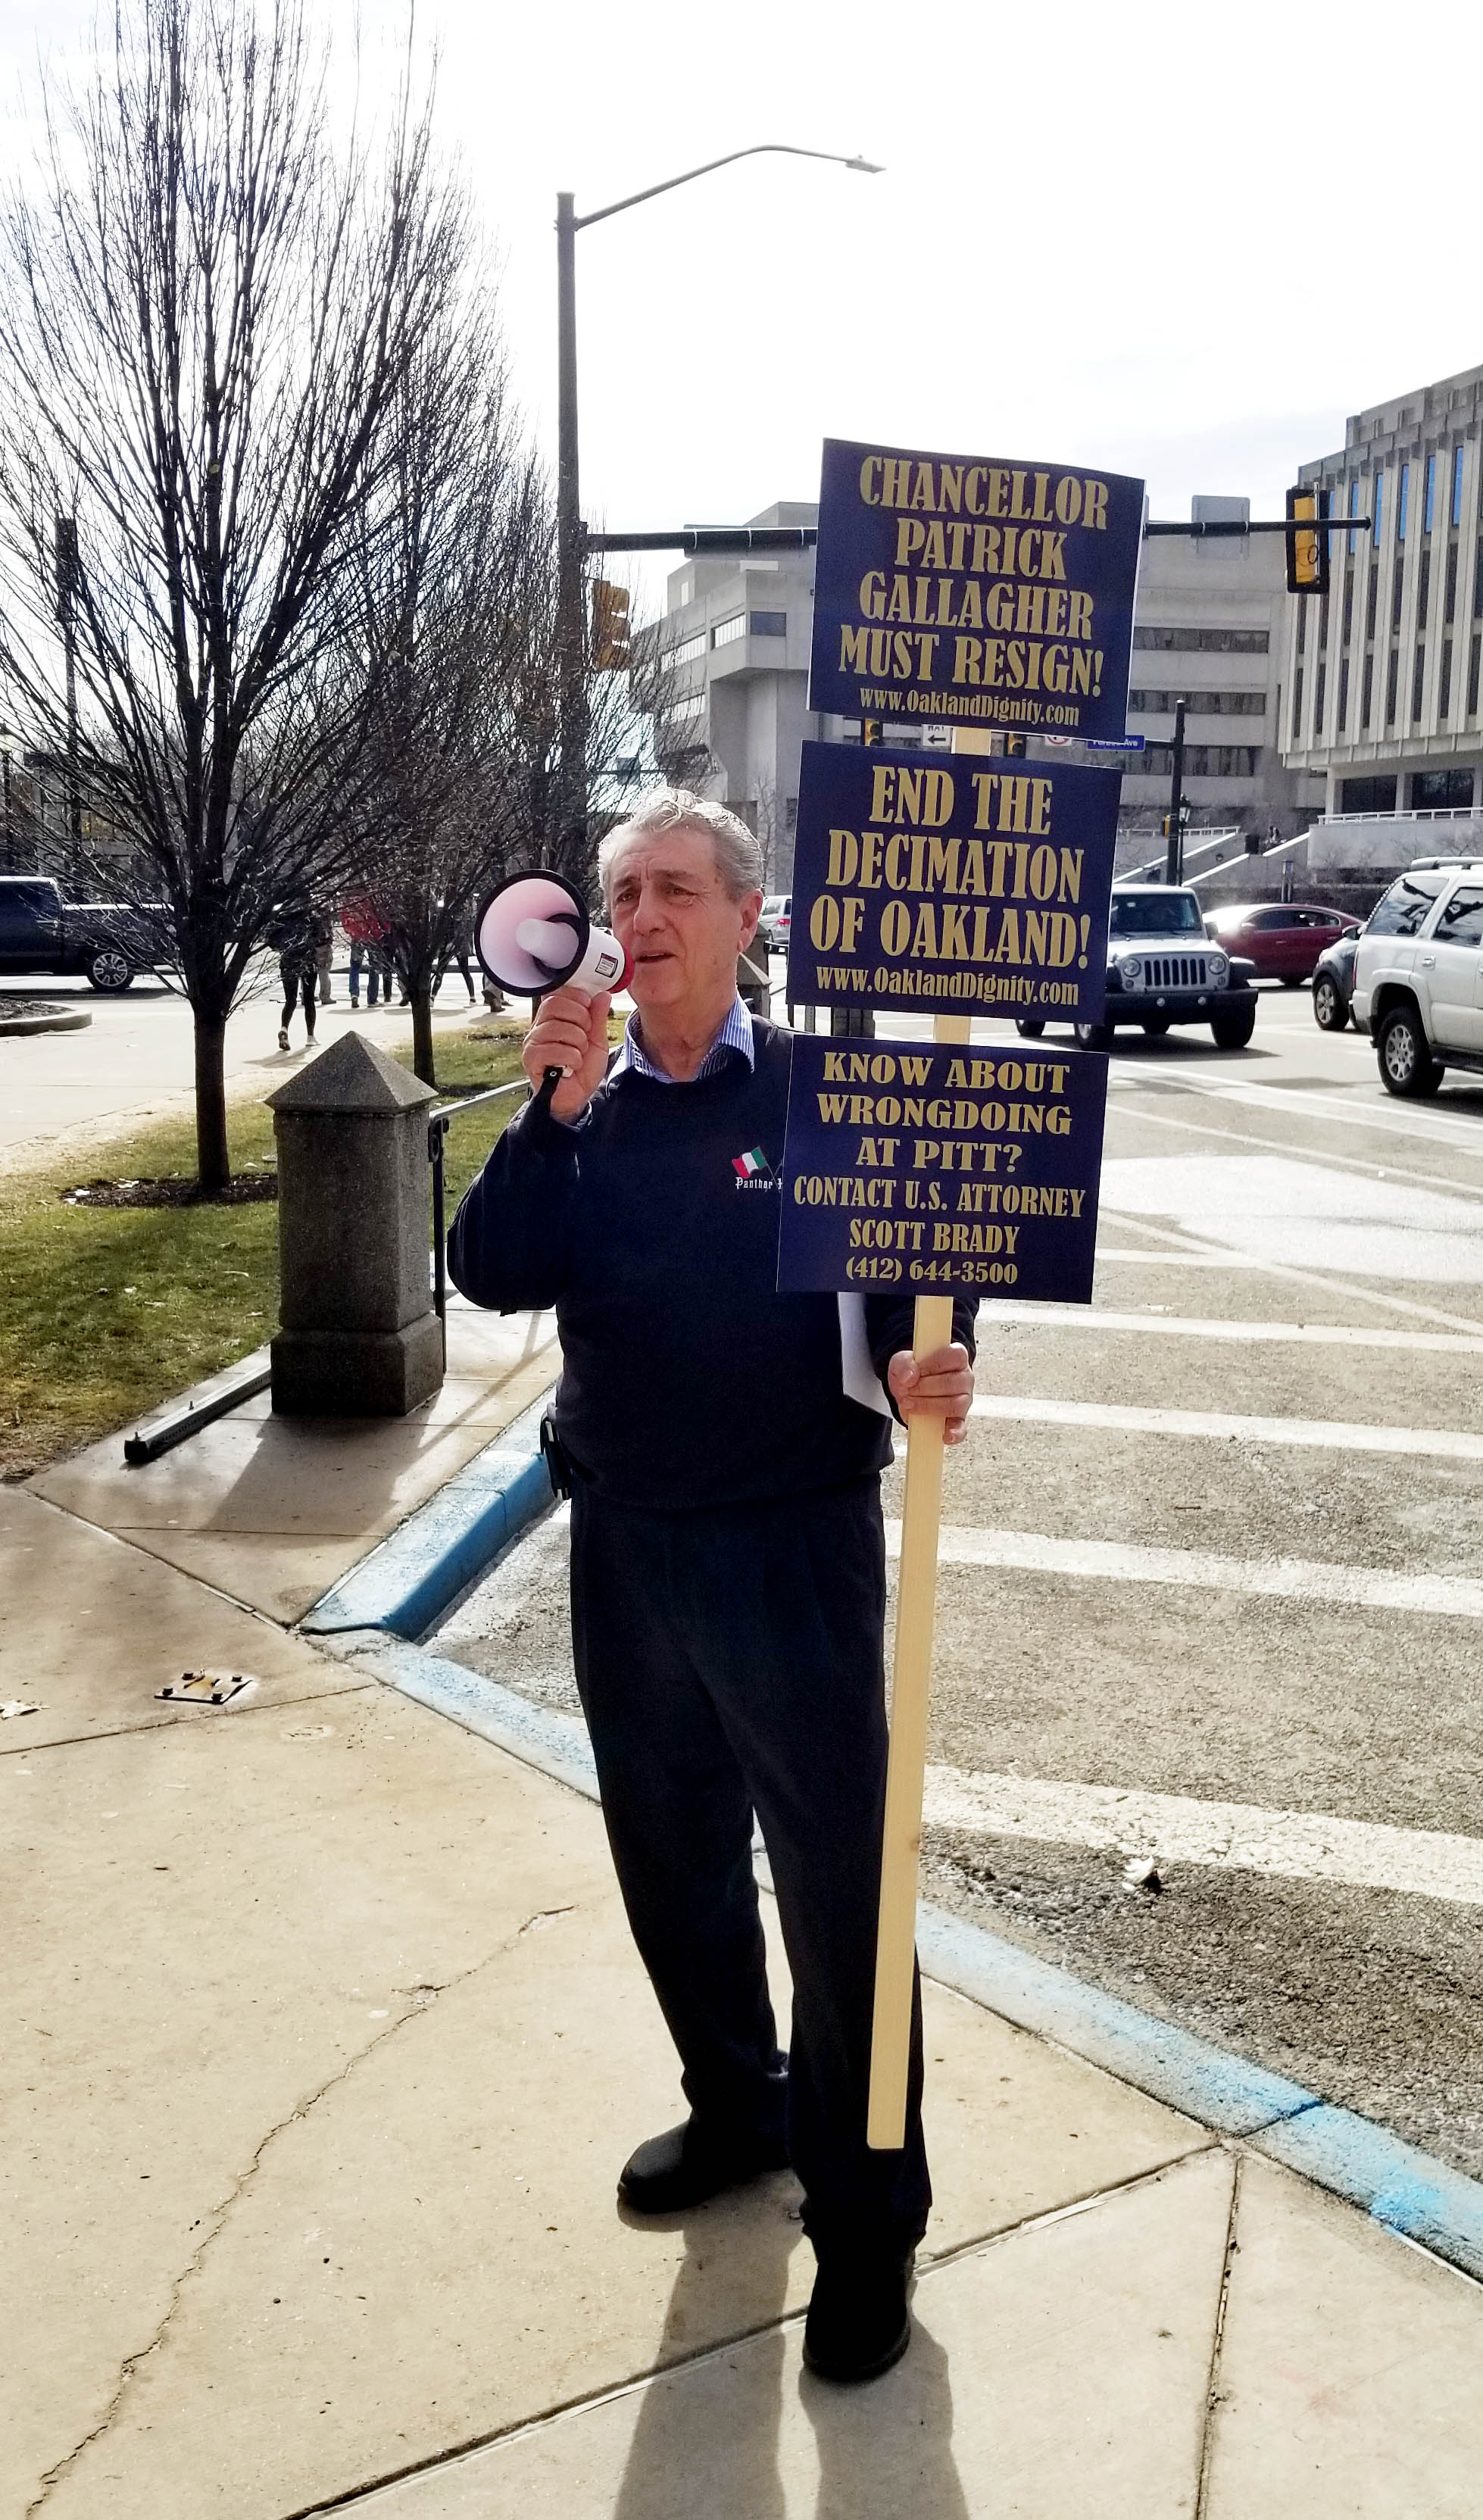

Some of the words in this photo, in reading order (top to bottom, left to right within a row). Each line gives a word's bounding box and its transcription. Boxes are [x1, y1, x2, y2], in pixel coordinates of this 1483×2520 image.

[860, 455, 1109, 530] CHANCELLOR
[894, 517, 1068, 580] PATRICK
[859, 570, 1094, 641] GALLAGHER
[838, 624, 940, 681] MUST
[951, 635, 1104, 698] RESIGN!
[860, 687, 1079, 726] www.OaklandDignity.com
[869, 765, 954, 826] END
[971, 773, 1053, 835] THE
[825, 829, 1085, 904] DECIMATION
[810, 895, 866, 953] OF
[879, 900, 1091, 970] OAKLAND!
[816, 966, 1079, 1006] www.OaklandDignity.com
[823, 1051, 934, 1086] KNOW
[944, 1059, 1070, 1094] ABOUT
[816, 1093, 1072, 1135] WRONGDOING
[855, 1136, 901, 1167] AT
[912, 1139, 1022, 1173] PITT?
[735, 1176, 773, 1190] Panther
[794, 1176, 897, 1208] CONTACT
[905, 1180, 948, 1210] U.S.
[956, 1183, 1086, 1217] ATTORNEY
[849, 1218, 926, 1251] SCOTT
[932, 1223, 1020, 1254] BRADY
[846, 1256, 903, 1282] (412)
[909, 1259, 1018, 1284] 644-3500
